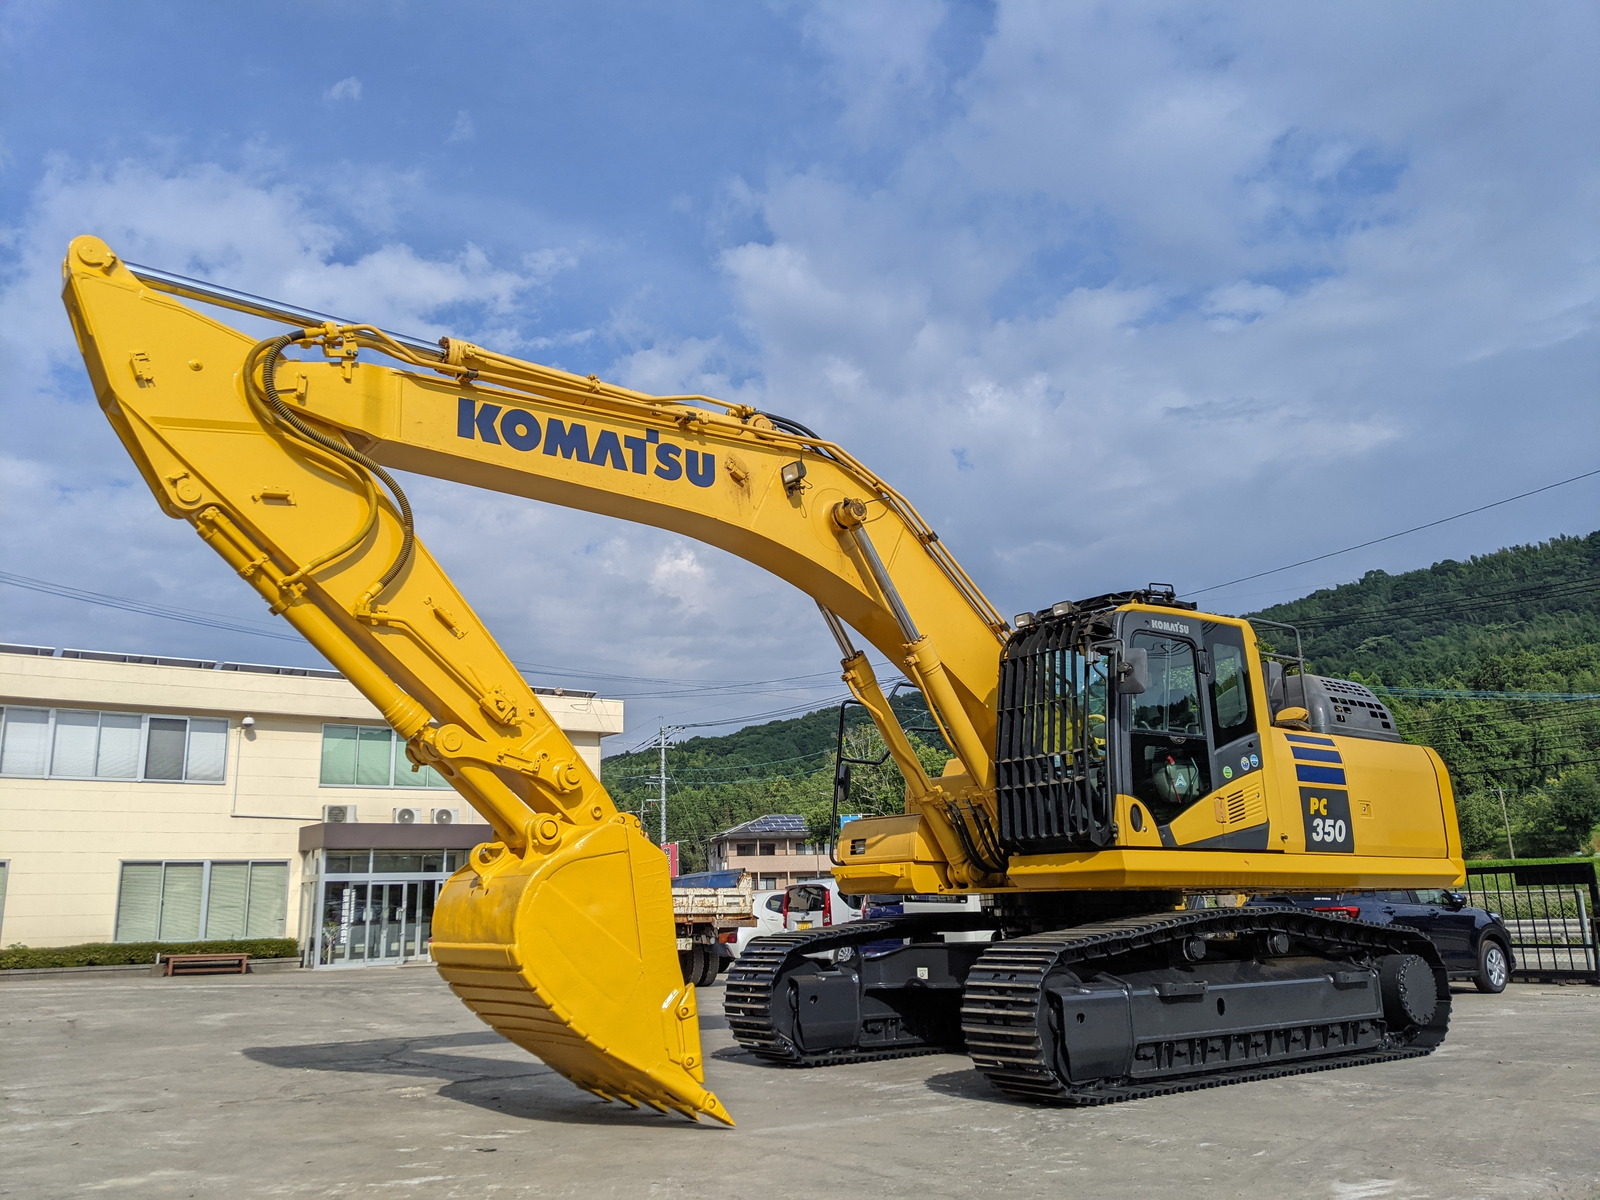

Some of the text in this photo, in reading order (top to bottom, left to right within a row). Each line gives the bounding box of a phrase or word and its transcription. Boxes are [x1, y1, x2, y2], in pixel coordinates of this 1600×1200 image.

[457, 397, 715, 488] KOMATSU
[1151, 619, 1190, 634] KOMATSU
[1310, 797, 1328, 816] PC
[1312, 817, 1346, 843] 350
